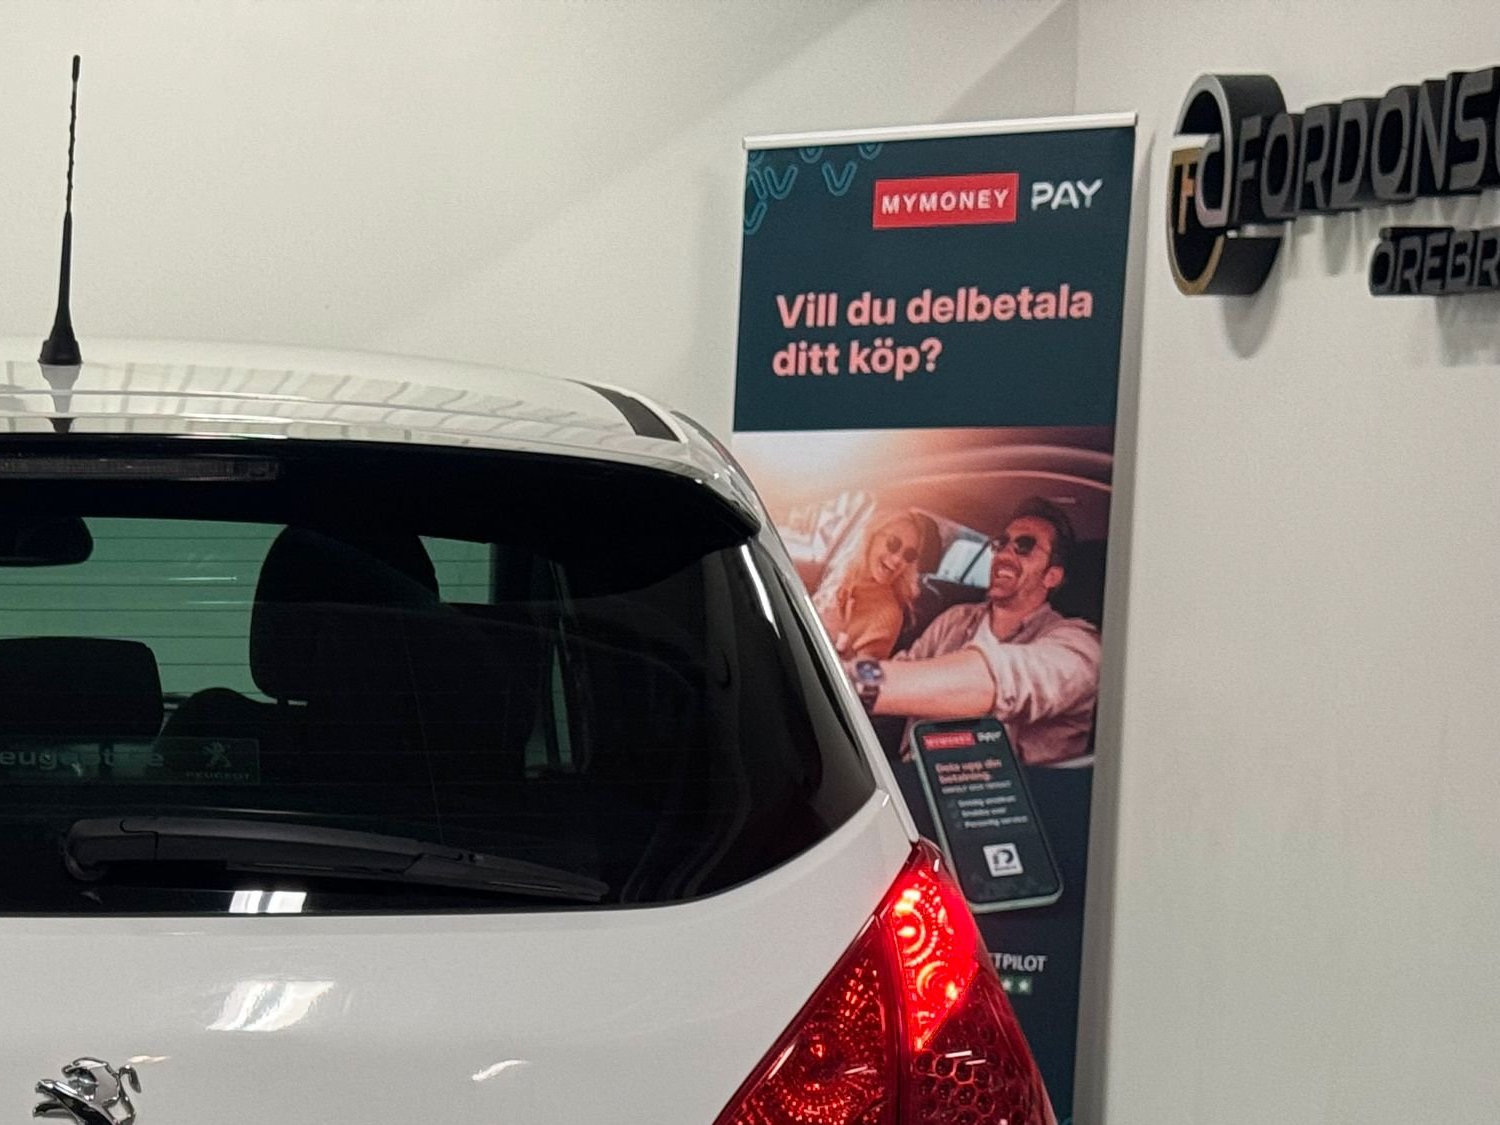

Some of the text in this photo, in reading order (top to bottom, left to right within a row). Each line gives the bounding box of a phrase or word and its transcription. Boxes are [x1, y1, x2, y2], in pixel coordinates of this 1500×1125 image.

[1233, 67, 1500, 226] FORDONS
[881, 179, 1102, 215] MYMONEY PAY
[775, 284, 1094, 328] Vill du delbetala
[772, 337, 944, 381] ditt köp?
[988, 952, 1047, 973] TPILOT
